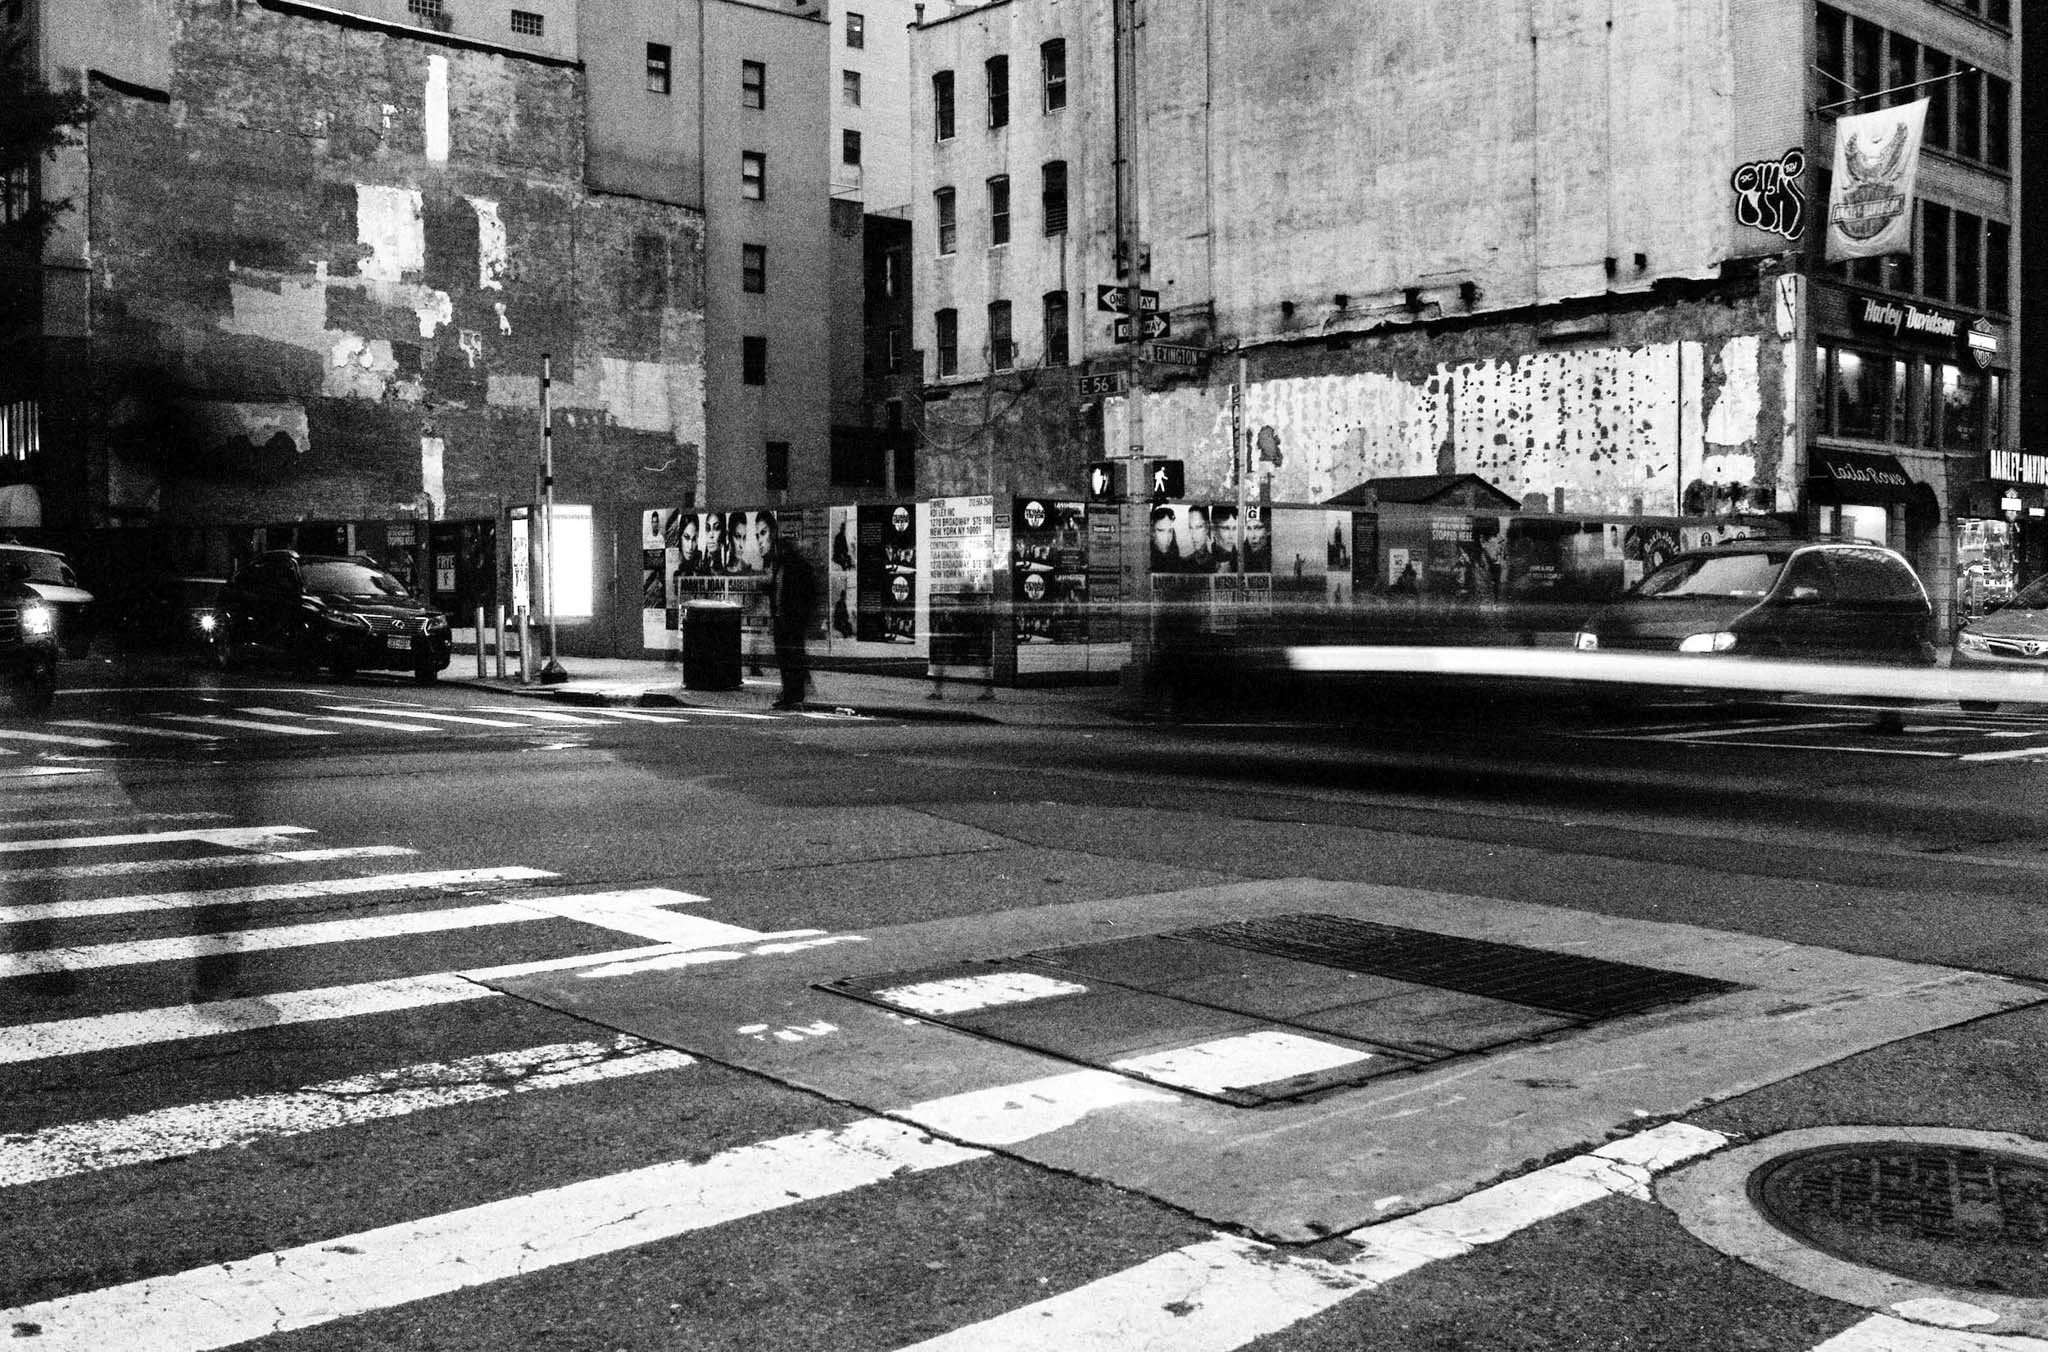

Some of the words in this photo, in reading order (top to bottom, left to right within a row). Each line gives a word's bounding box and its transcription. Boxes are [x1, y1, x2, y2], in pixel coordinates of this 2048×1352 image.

[1141, 297, 1153, 308] AY
[1155, 347, 1198, 365] EXINGTON
[1081, 379, 1089, 394] E
[1093, 377, 1109, 393] 56
